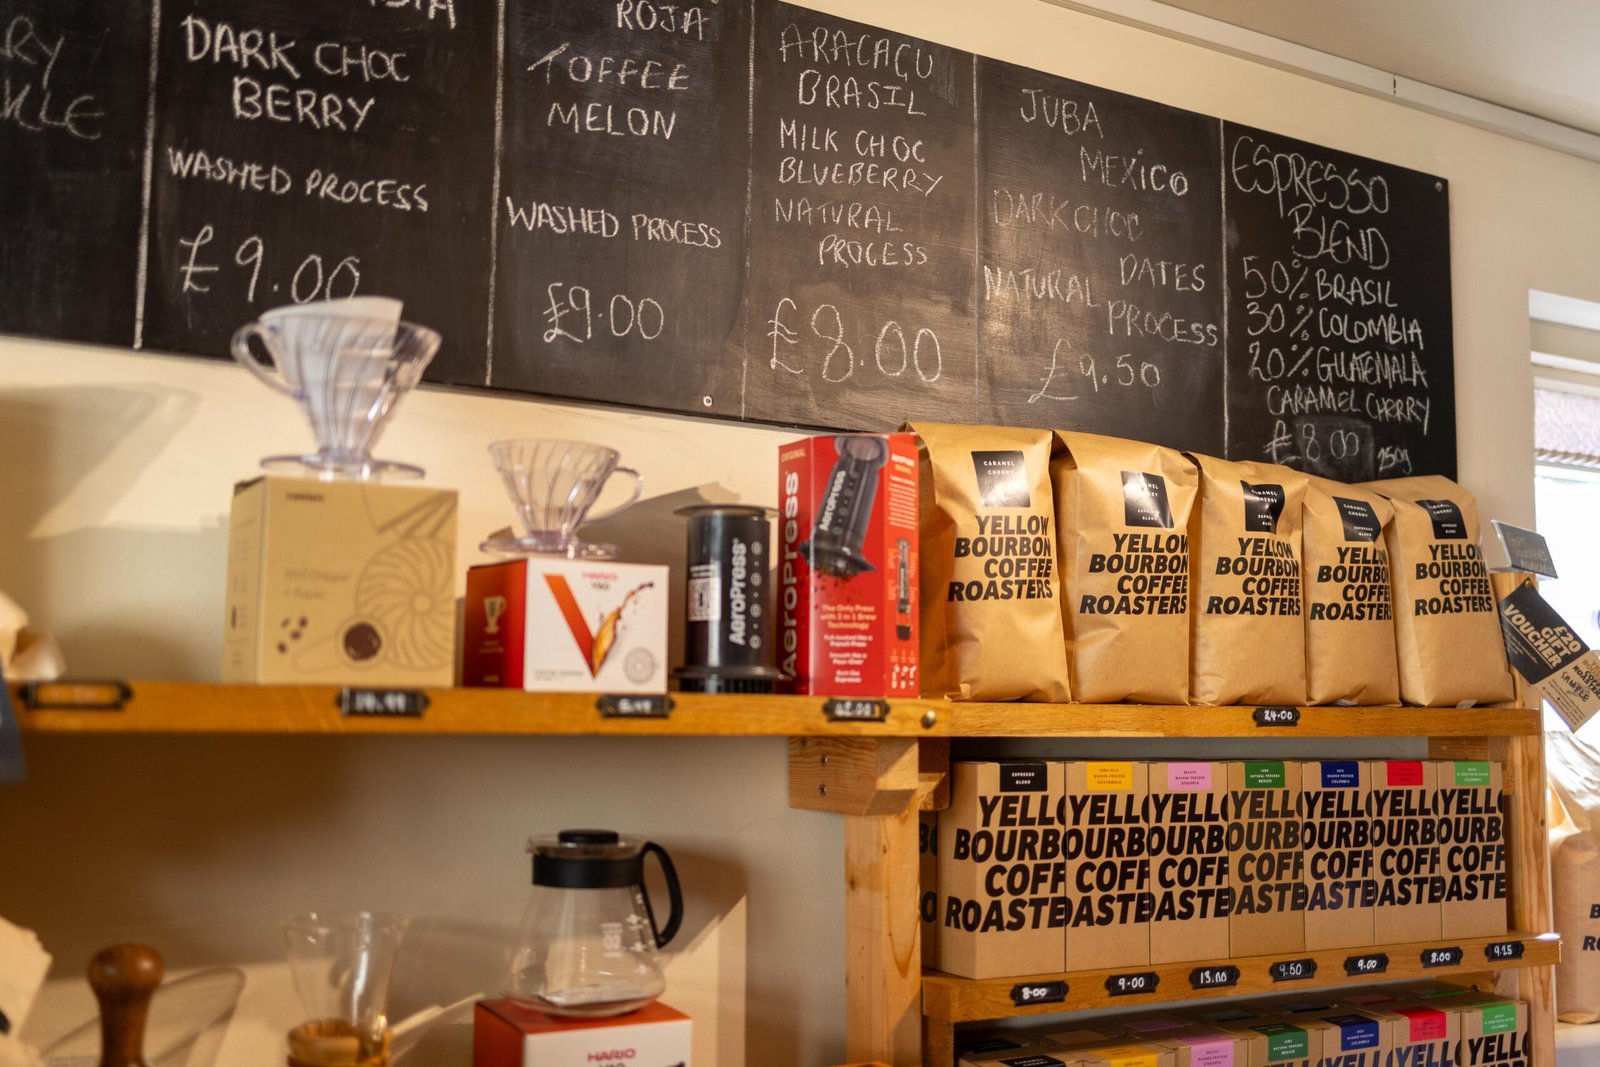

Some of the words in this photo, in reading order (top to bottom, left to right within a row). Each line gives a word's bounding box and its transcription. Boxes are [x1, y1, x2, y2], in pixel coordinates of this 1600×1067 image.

[616, 0, 709, 41] ROJA
[181, 14, 300, 79] DARK
[314, 42, 410, 82] CHOC
[527, 42, 690, 90] TOFFEE
[233, 76, 375, 131] BERRY
[798, 69, 926, 116] BRASIL
[547, 102, 676, 140] MELON
[1020, 88, 1104, 139] JUBA
[780, 118, 839, 152] MILK
[855, 130, 926, 163] CHOC
[168, 147, 292, 194] WASHED
[305, 169, 428, 211] PROCESS
[778, 157, 943, 197] BLUEBERRY
[1232, 136, 1389, 218] ESPRESSO
[506, 196, 619, 238] WASHED
[631, 213, 721, 249] PROCESS
[775, 198, 904, 233] NATURAL
[993, 188, 1072, 232] DARK
[1073, 205, 1143, 242] CHOC
[818, 234, 928, 268] PROCESS
[1287, 203, 1390, 270] BLEND
[983, 265, 1101, 308] NATURAL
[1119, 253, 1205, 292] DATES
[1242, 256, 1309, 300] 50%
[1315, 268, 1398, 307] BRASIL
[543, 282, 664, 343] £9.00
[1107, 300, 1218, 347] PROCESS
[1246, 301, 1314, 341] 30%
[1318, 308, 1424, 350] COLOMBIA
[767, 297, 942, 382] £8.00
[1027, 338, 1160, 403] £9.50
[1248, 341, 1314, 382] 20%
[1315, 346, 1428, 389] GUATEMALA
[1266, 384, 1361, 416] CARAMEL
[975, 515, 1049, 536] YELLOW
[954, 537, 1051, 558] BOURBON
[1238, 537, 1294, 559] YELLOW
[984, 558, 1053, 578] COFFEE
[1117, 575, 1187, 594] COFFEE
[1215, 556, 1299, 577] BOURBON
[1416, 561, 1487, 580] BOURBON
[947, 579, 1053, 602] ROASTERS
[1242, 577, 1299, 596] COFFEE
[1439, 579, 1490, 596] COFFEE
[1079, 595, 1187, 615] ROASTERS
[1206, 596, 1300, 616] ROASTERS
[1415, 596, 1493, 616] ROASTERS
[1503, 603, 1562, 669] VOUCHER
[1540, 626, 1572, 657] GIFT
[1553, 625, 1582, 653] £20
[1560, 671, 1590, 702] SAMPLE
[954, 828, 1065, 863] BOURB
[1278, 963, 1303, 977] 9.50
[1357, 958, 1377, 970] 9.00
[1430, 951, 1451, 963] 8.00
[587, 1048, 636, 1063] HARIO
